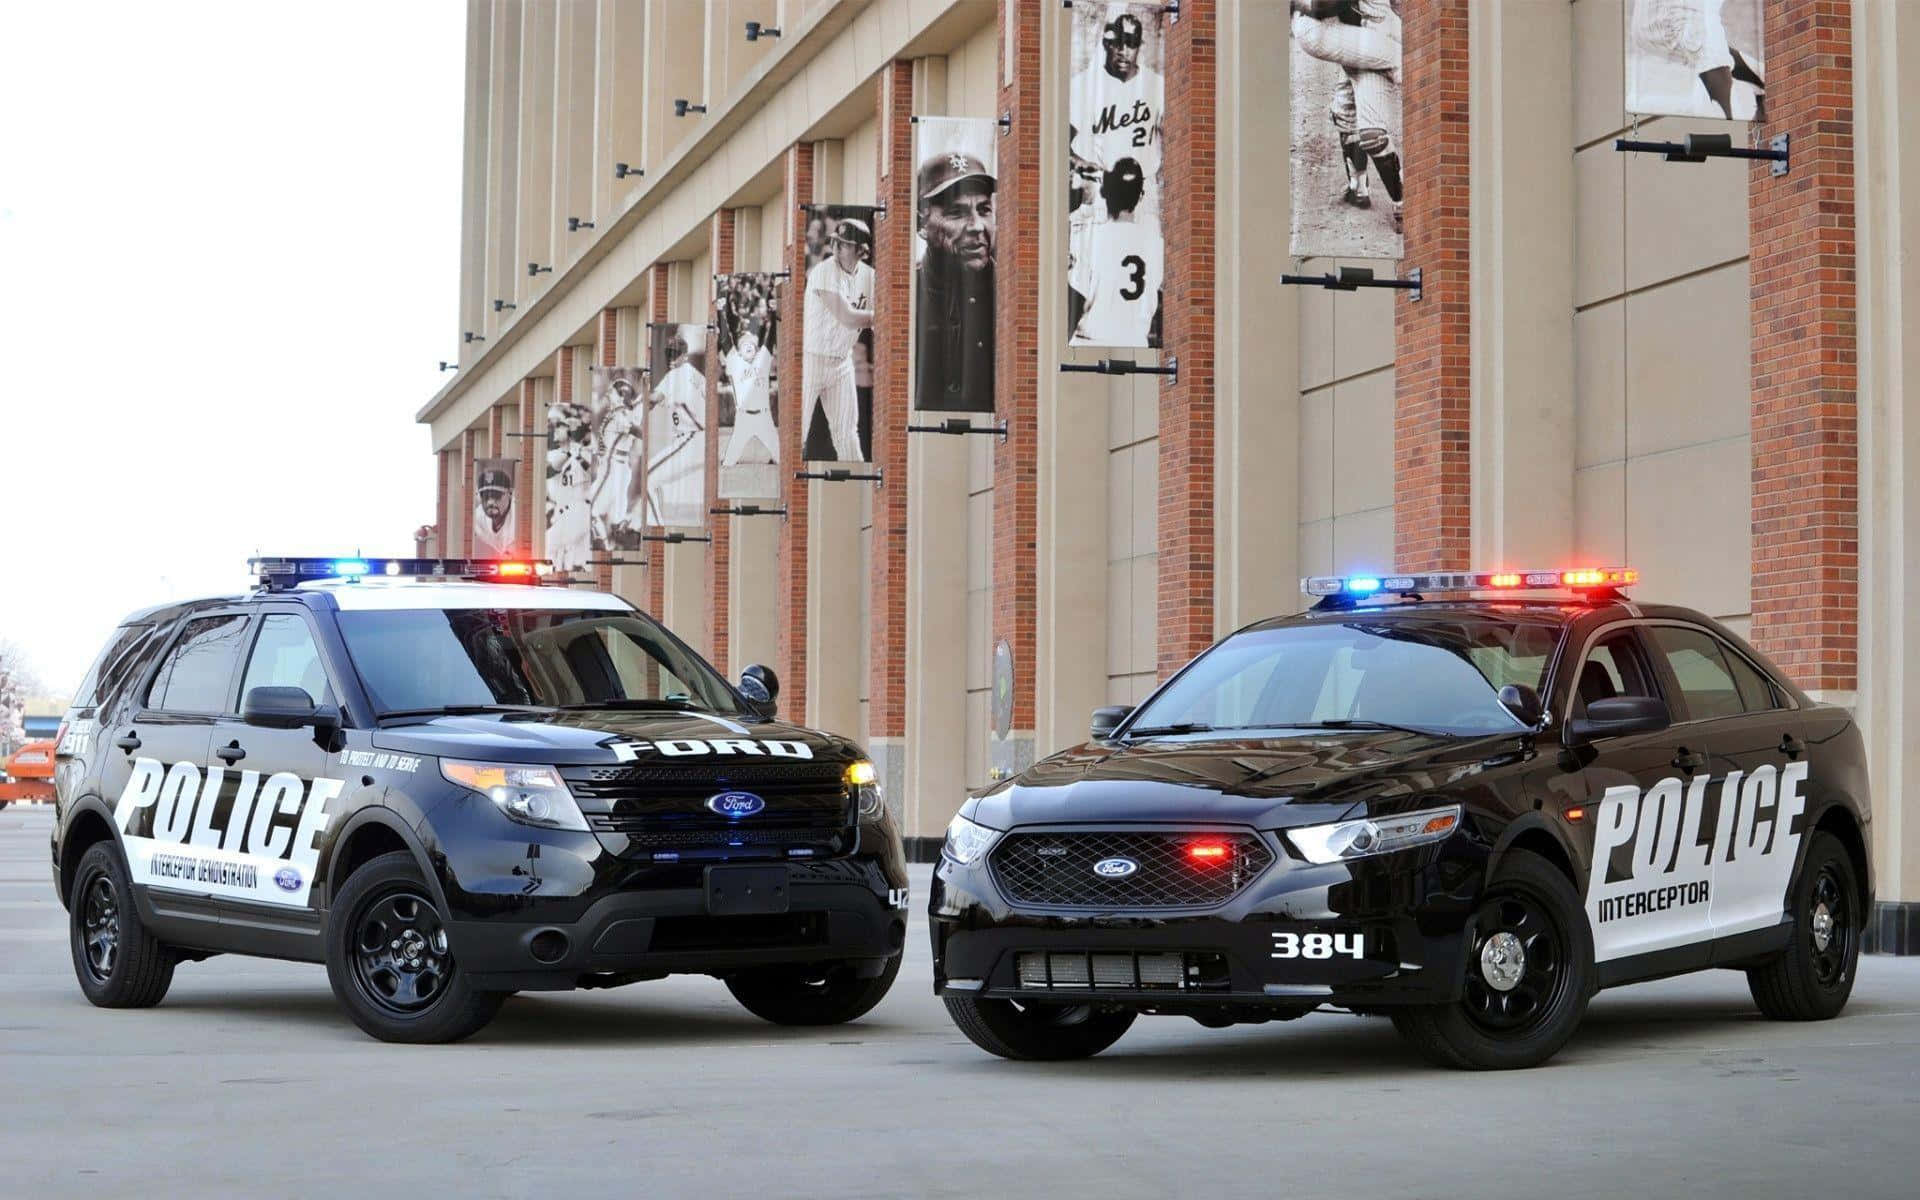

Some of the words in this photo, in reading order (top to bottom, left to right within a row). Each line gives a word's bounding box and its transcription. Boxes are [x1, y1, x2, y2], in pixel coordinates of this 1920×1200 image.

[1092, 99, 1151, 134] Mets
[1120, 254, 1146, 301] 3
[672, 411, 680, 426] 6
[562, 474, 573, 487] 31
[609, 739, 814, 763] FORD
[113, 757, 346, 864] POLICE
[723, 795, 753, 811] Ford
[1591, 761, 1808, 886] POLICE
[150, 852, 196, 881] INTERCEPTOR
[198, 859, 258, 889] DEMONSTRATION
[280, 869, 298, 889] Ford
[1102, 862, 1126, 874] Ford
[1599, 880, 1709, 923] INTERCEPTOR
[1271, 932, 1364, 959] 384
